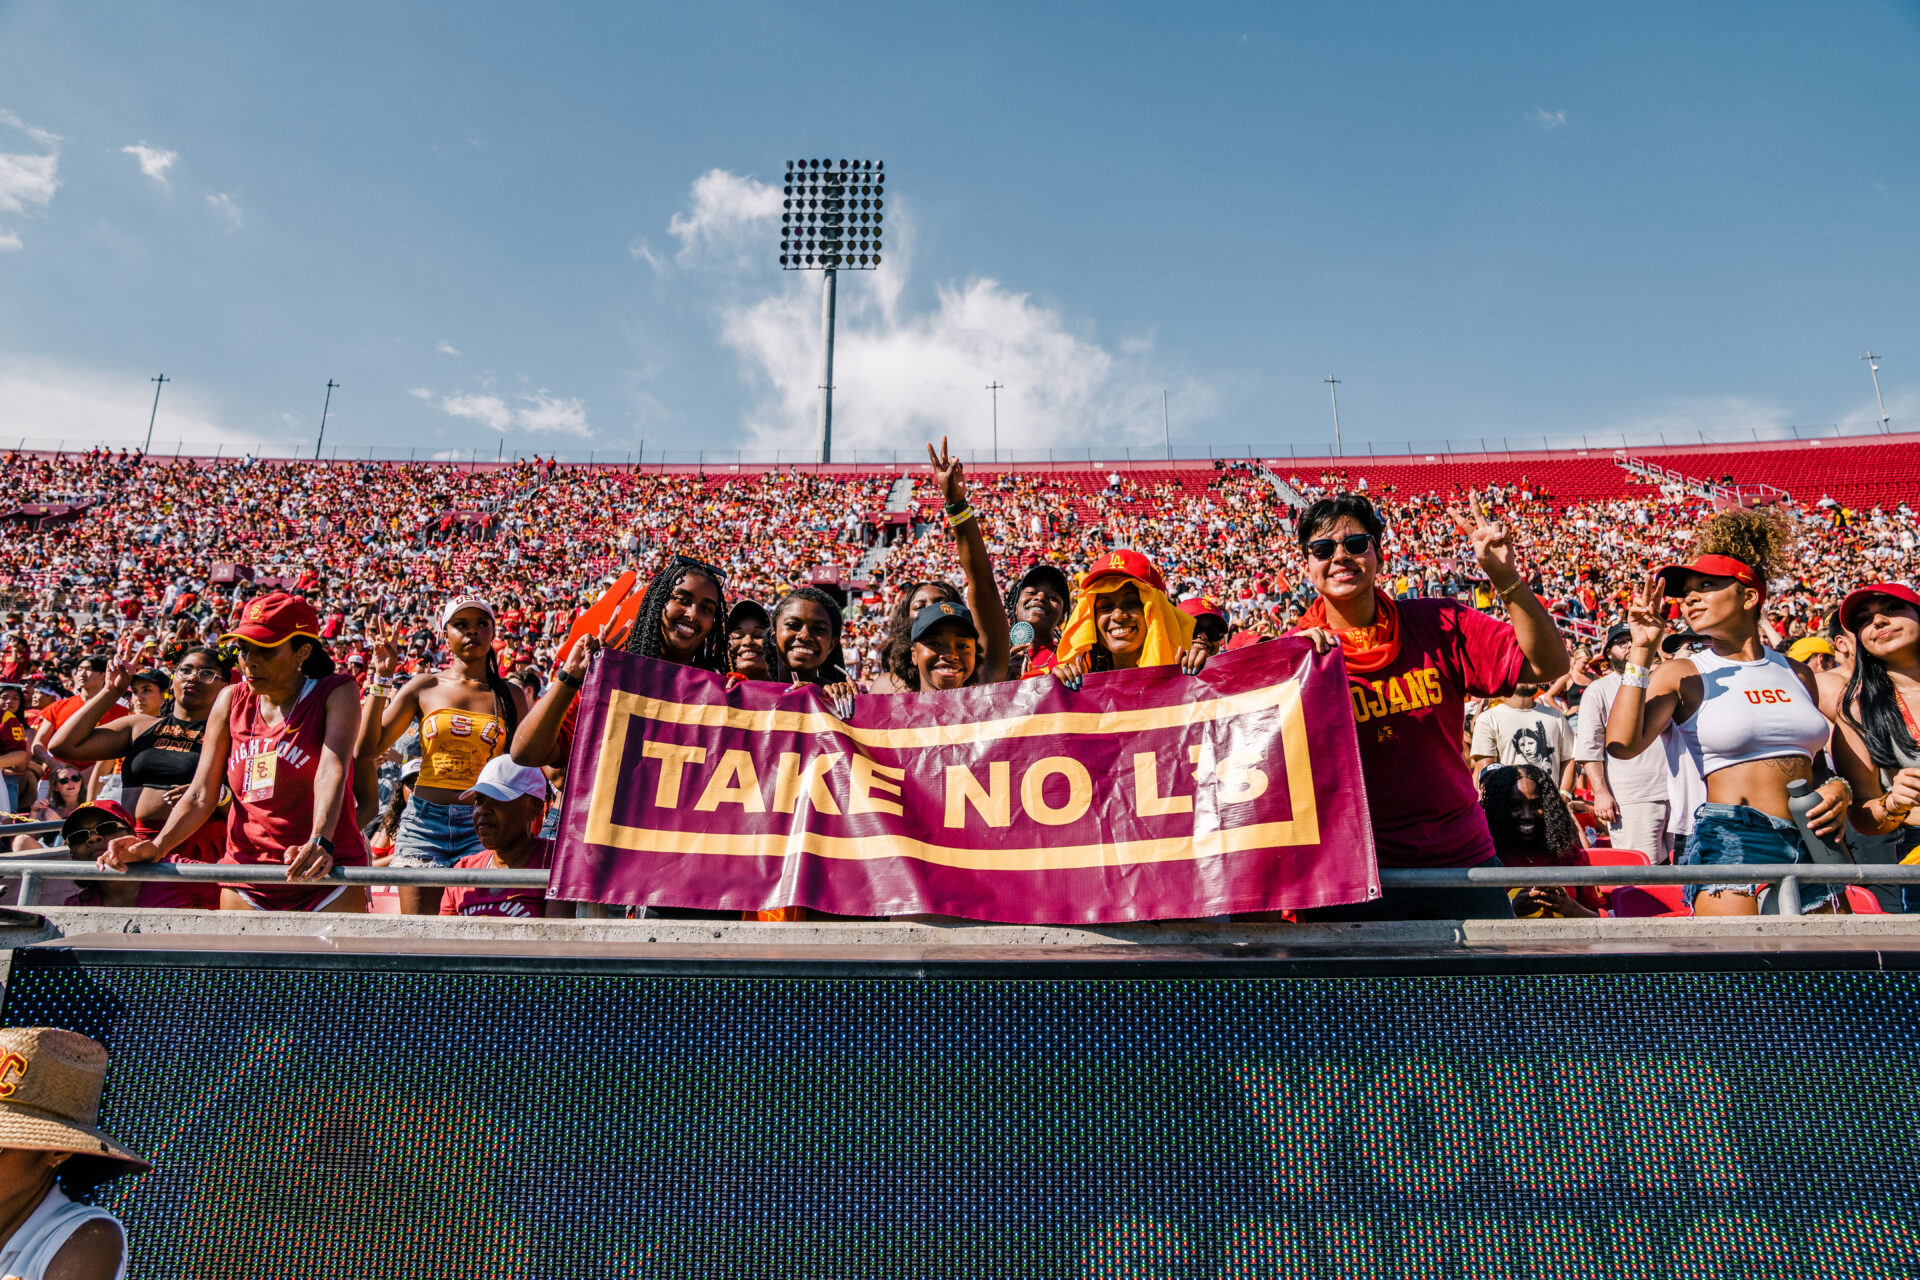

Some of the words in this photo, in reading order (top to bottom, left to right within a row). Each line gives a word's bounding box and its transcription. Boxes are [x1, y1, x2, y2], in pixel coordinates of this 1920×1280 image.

[1109, 553, 1125, 569] LA
[217, 568, 229, 577] 23
[818, 570, 831, 579] 24
[1744, 688, 1792, 704] USC
[277, 740, 310, 769] ON!
[641, 740, 906, 817] TAKE
[944, 756, 1093, 826] NO
[1223, 1058, 1756, 1198] YOUR
